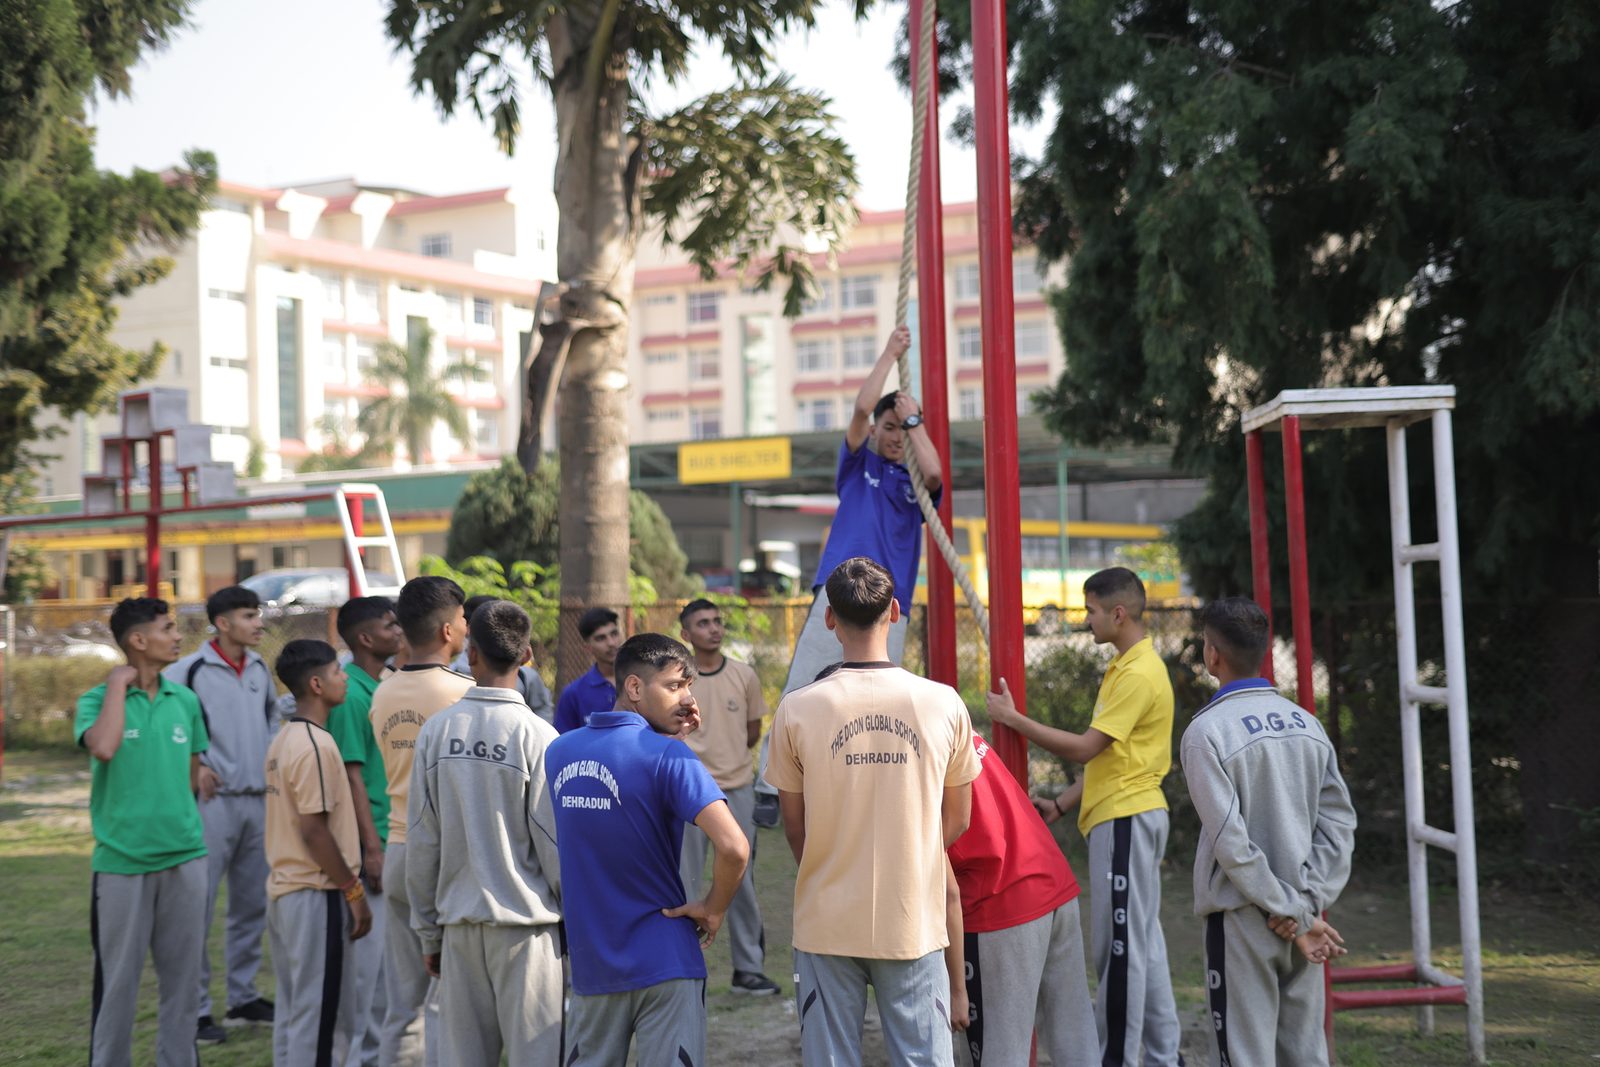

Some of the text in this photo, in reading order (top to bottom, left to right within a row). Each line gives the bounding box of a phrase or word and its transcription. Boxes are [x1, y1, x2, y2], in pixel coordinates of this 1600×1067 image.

[1241, 711, 1306, 735] D.G.S
[831, 714, 921, 759] THE DOON GLOBAL SCHOOL
[449, 738, 508, 761] D.G.S
[845, 752, 908, 765] DEHRADUN
[562, 761, 580, 784] DOON
[579, 760, 600, 779] GLOBAL
[600, 764, 621, 806] SCHOOL
[562, 796, 611, 810] DEHRADUN
